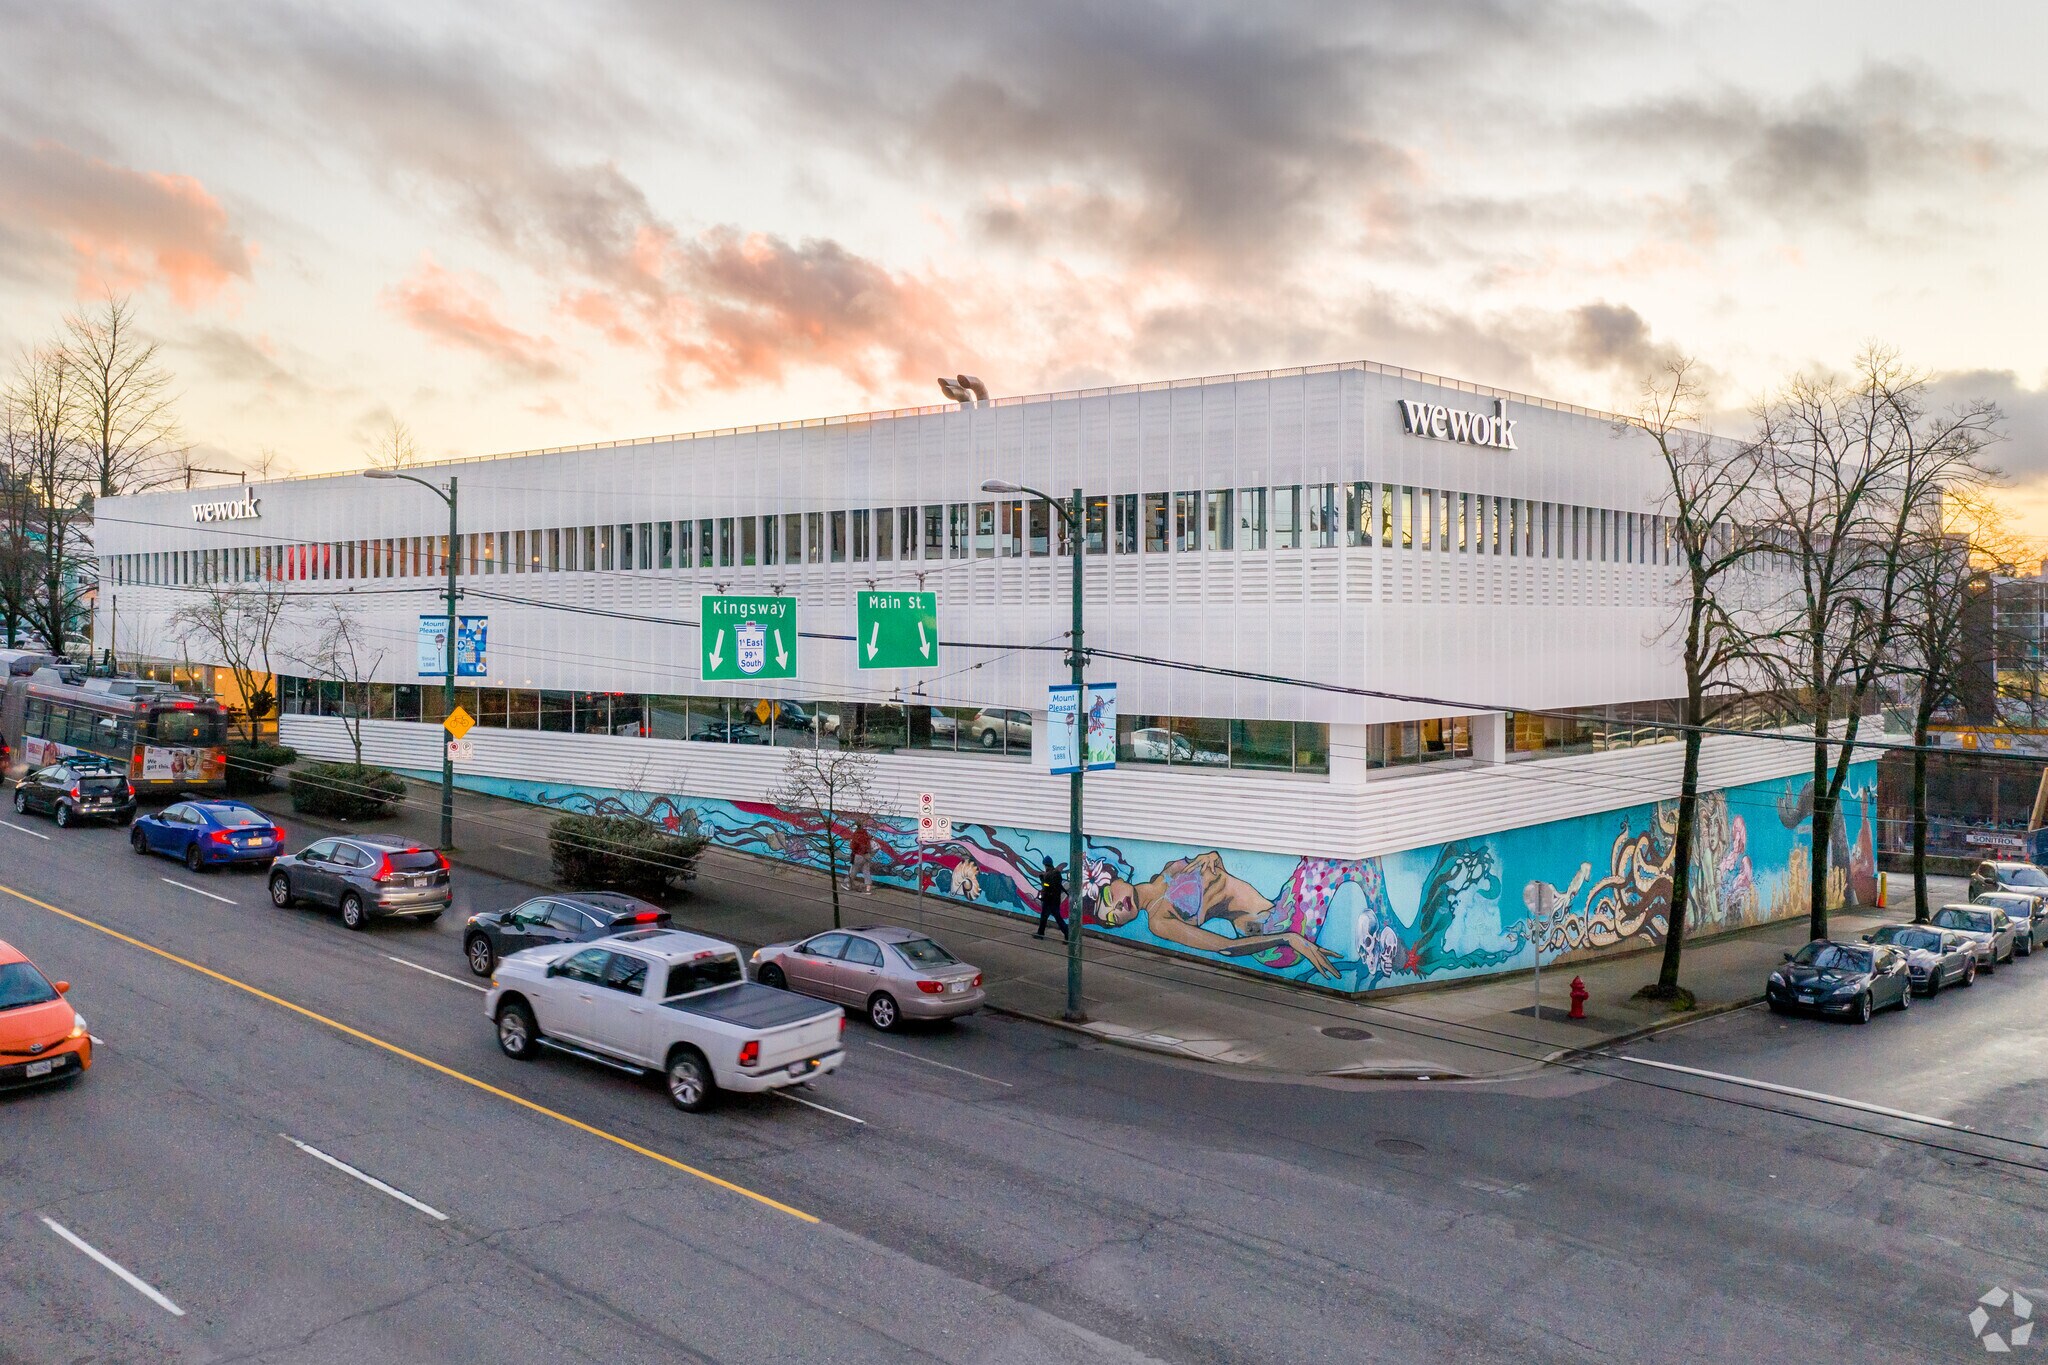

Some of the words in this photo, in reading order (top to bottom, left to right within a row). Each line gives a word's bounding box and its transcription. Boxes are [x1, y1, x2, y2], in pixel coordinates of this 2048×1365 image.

[1398, 398, 1518, 450] wework
[191, 487, 261, 522] wework
[869, 595, 901, 609] Main
[908, 596, 926, 609] St.
[713, 600, 787, 618] Kingsway
[746, 638, 763, 647] East
[740, 659, 762, 668] South
[1052, 694, 1075, 702] Mount
[1048, 703, 1077, 712] Pleasant
[192, 728, 200, 737] 3
[1972, 835, 2014, 845] SONITROL
